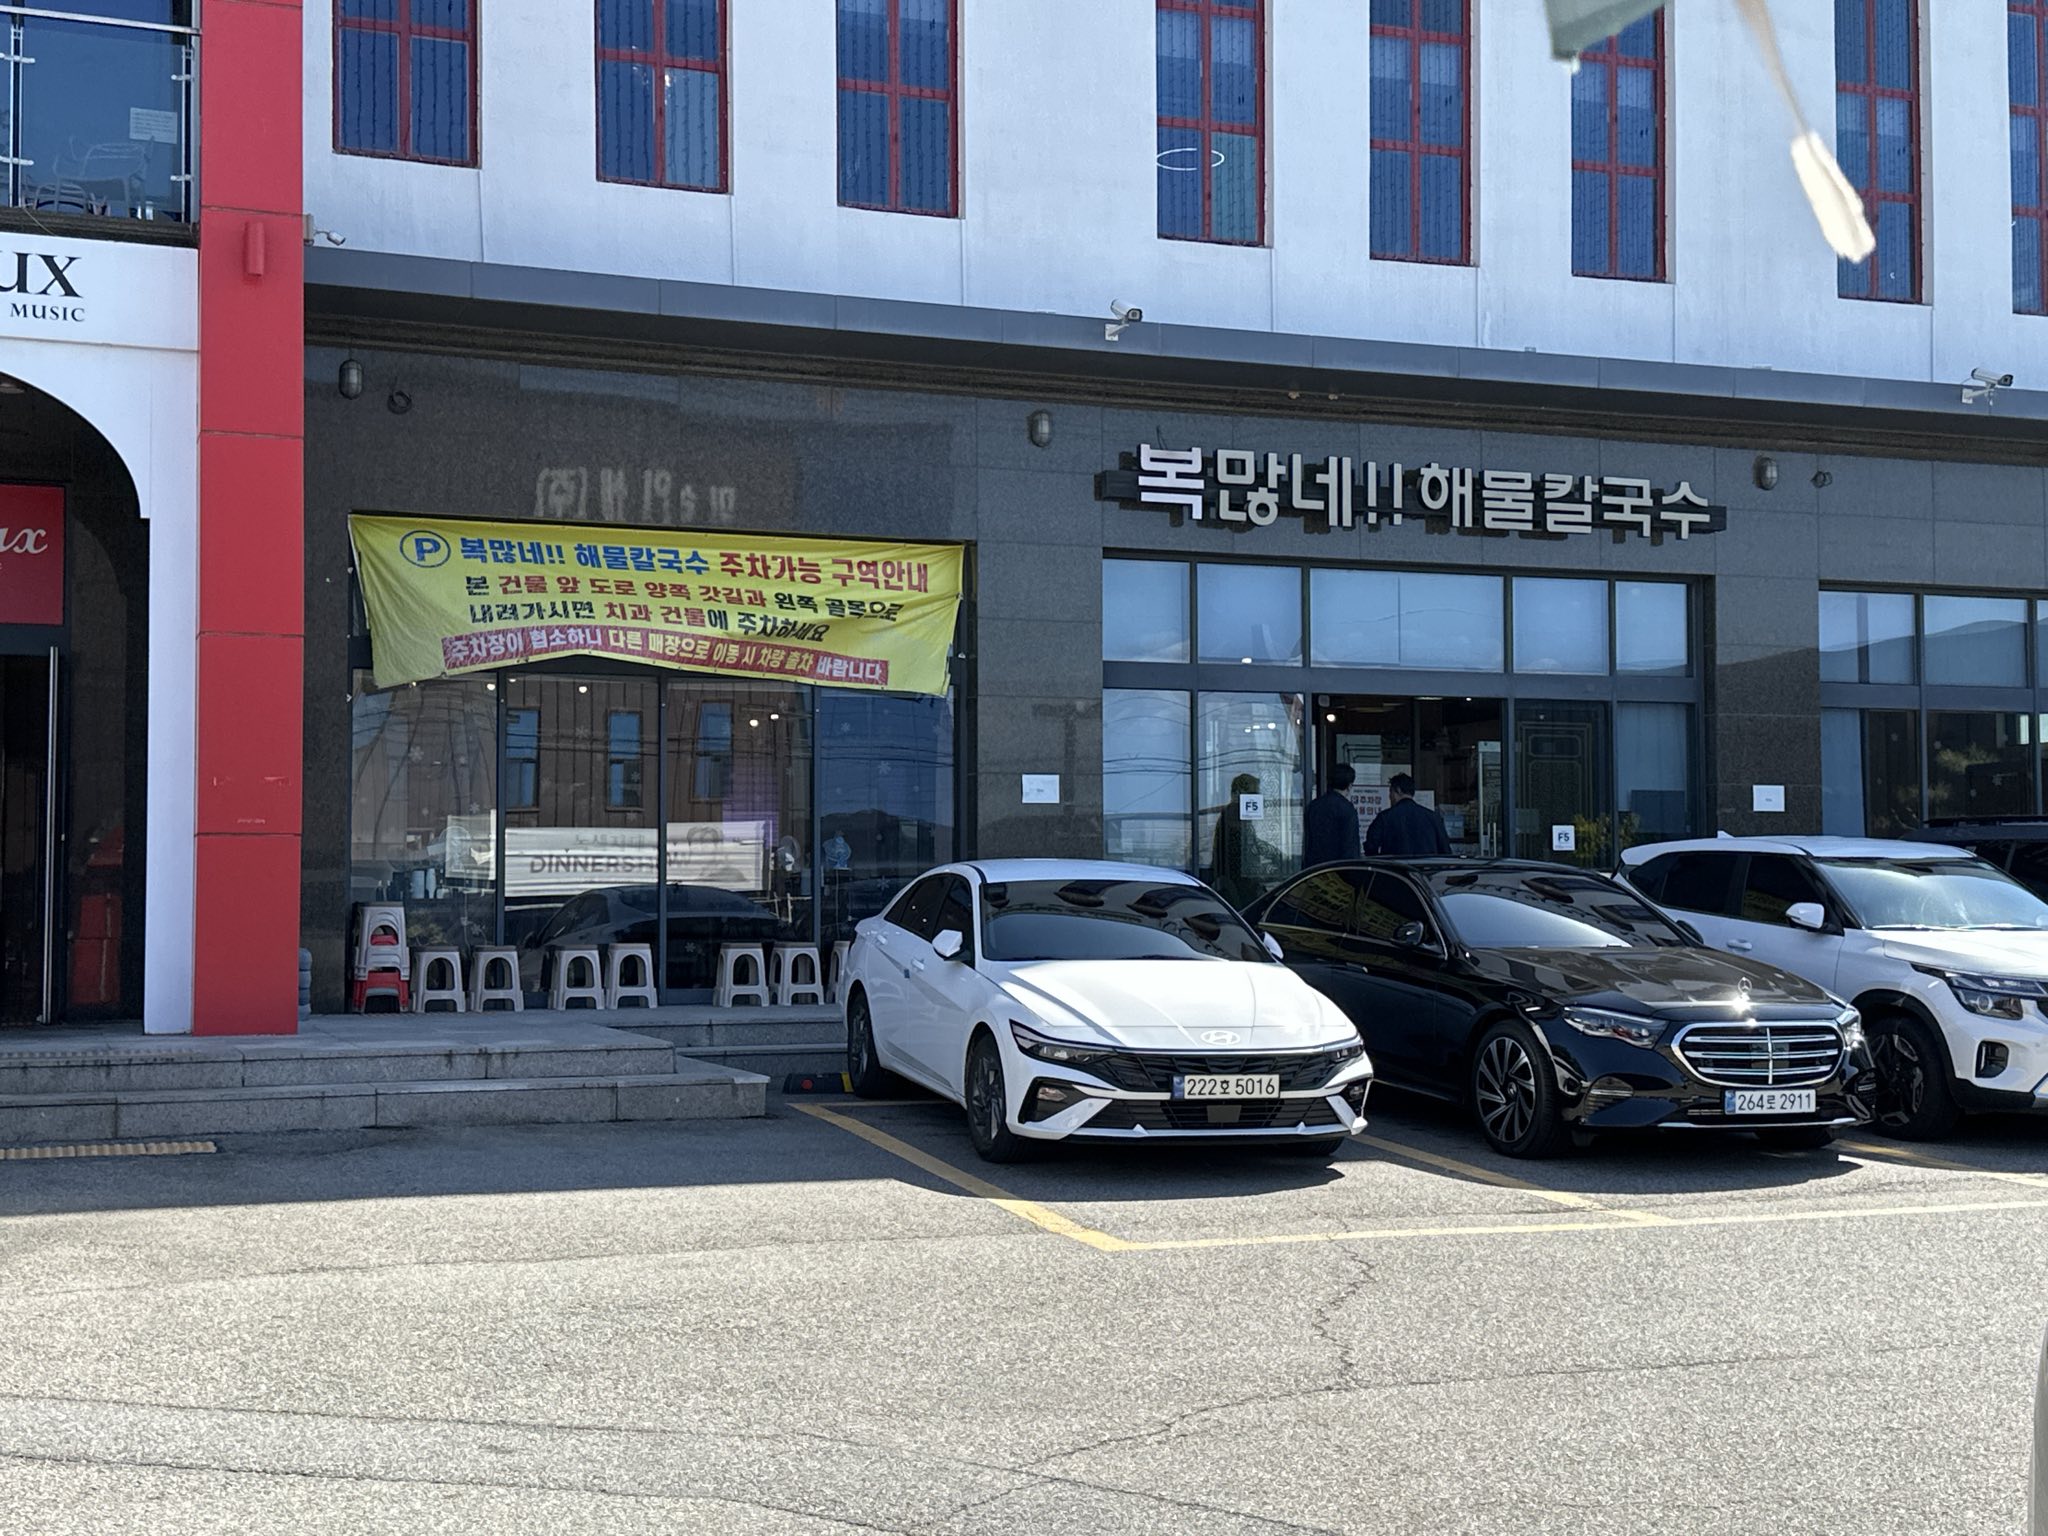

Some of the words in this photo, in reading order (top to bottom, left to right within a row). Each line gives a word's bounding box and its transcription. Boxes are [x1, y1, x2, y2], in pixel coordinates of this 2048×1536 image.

[10, 303, 85, 322] MUSIC
[1137, 443, 1403, 528] 복많네!!
[1419, 461, 1711, 540] 해물칼국수
[460, 537, 566, 565] 복많네!!
[574, 543, 710, 575] 해물칼국수
[719, 552, 822, 584] 주차가능
[831, 558, 929, 593] 구역안내
[465, 575, 490, 596] 본
[498, 575, 548, 594] 건물
[556, 576, 580, 594] 앞
[589, 577, 638, 596] 도로
[644, 581, 691, 601] 양쪽
[699, 585, 767, 608] 갓길과
[774, 592, 818, 614] 왼쪽
[824, 597, 904, 622] 골목으로
[470, 600, 596, 624] 내려가시면
[604, 601, 653, 623] 치과
[659, 605, 728, 631] 건물에
[737, 611, 830, 642] 주차하세요
[450, 632, 524, 662] 주차장이
[529, 626, 602, 651] 협소하니
[608, 629, 643, 651] 다른
[648, 632, 710, 660] 매장으로
[713, 642, 740, 664] 이동
[742, 646, 756, 666] 시
[757, 647, 786, 668] 차량
[785, 651, 814, 672] 출차
[816, 655, 882, 681] 바랍니다
[1245, 801, 1259, 811] F5
[1558, 832, 1570, 842] F5
[1187, 1078, 1230, 1096] 222호
[1235, 1078, 1275, 1095] 5016
[1738, 1093, 1776, 1111] 264로
[1780, 1093, 1811, 1110] 2911
